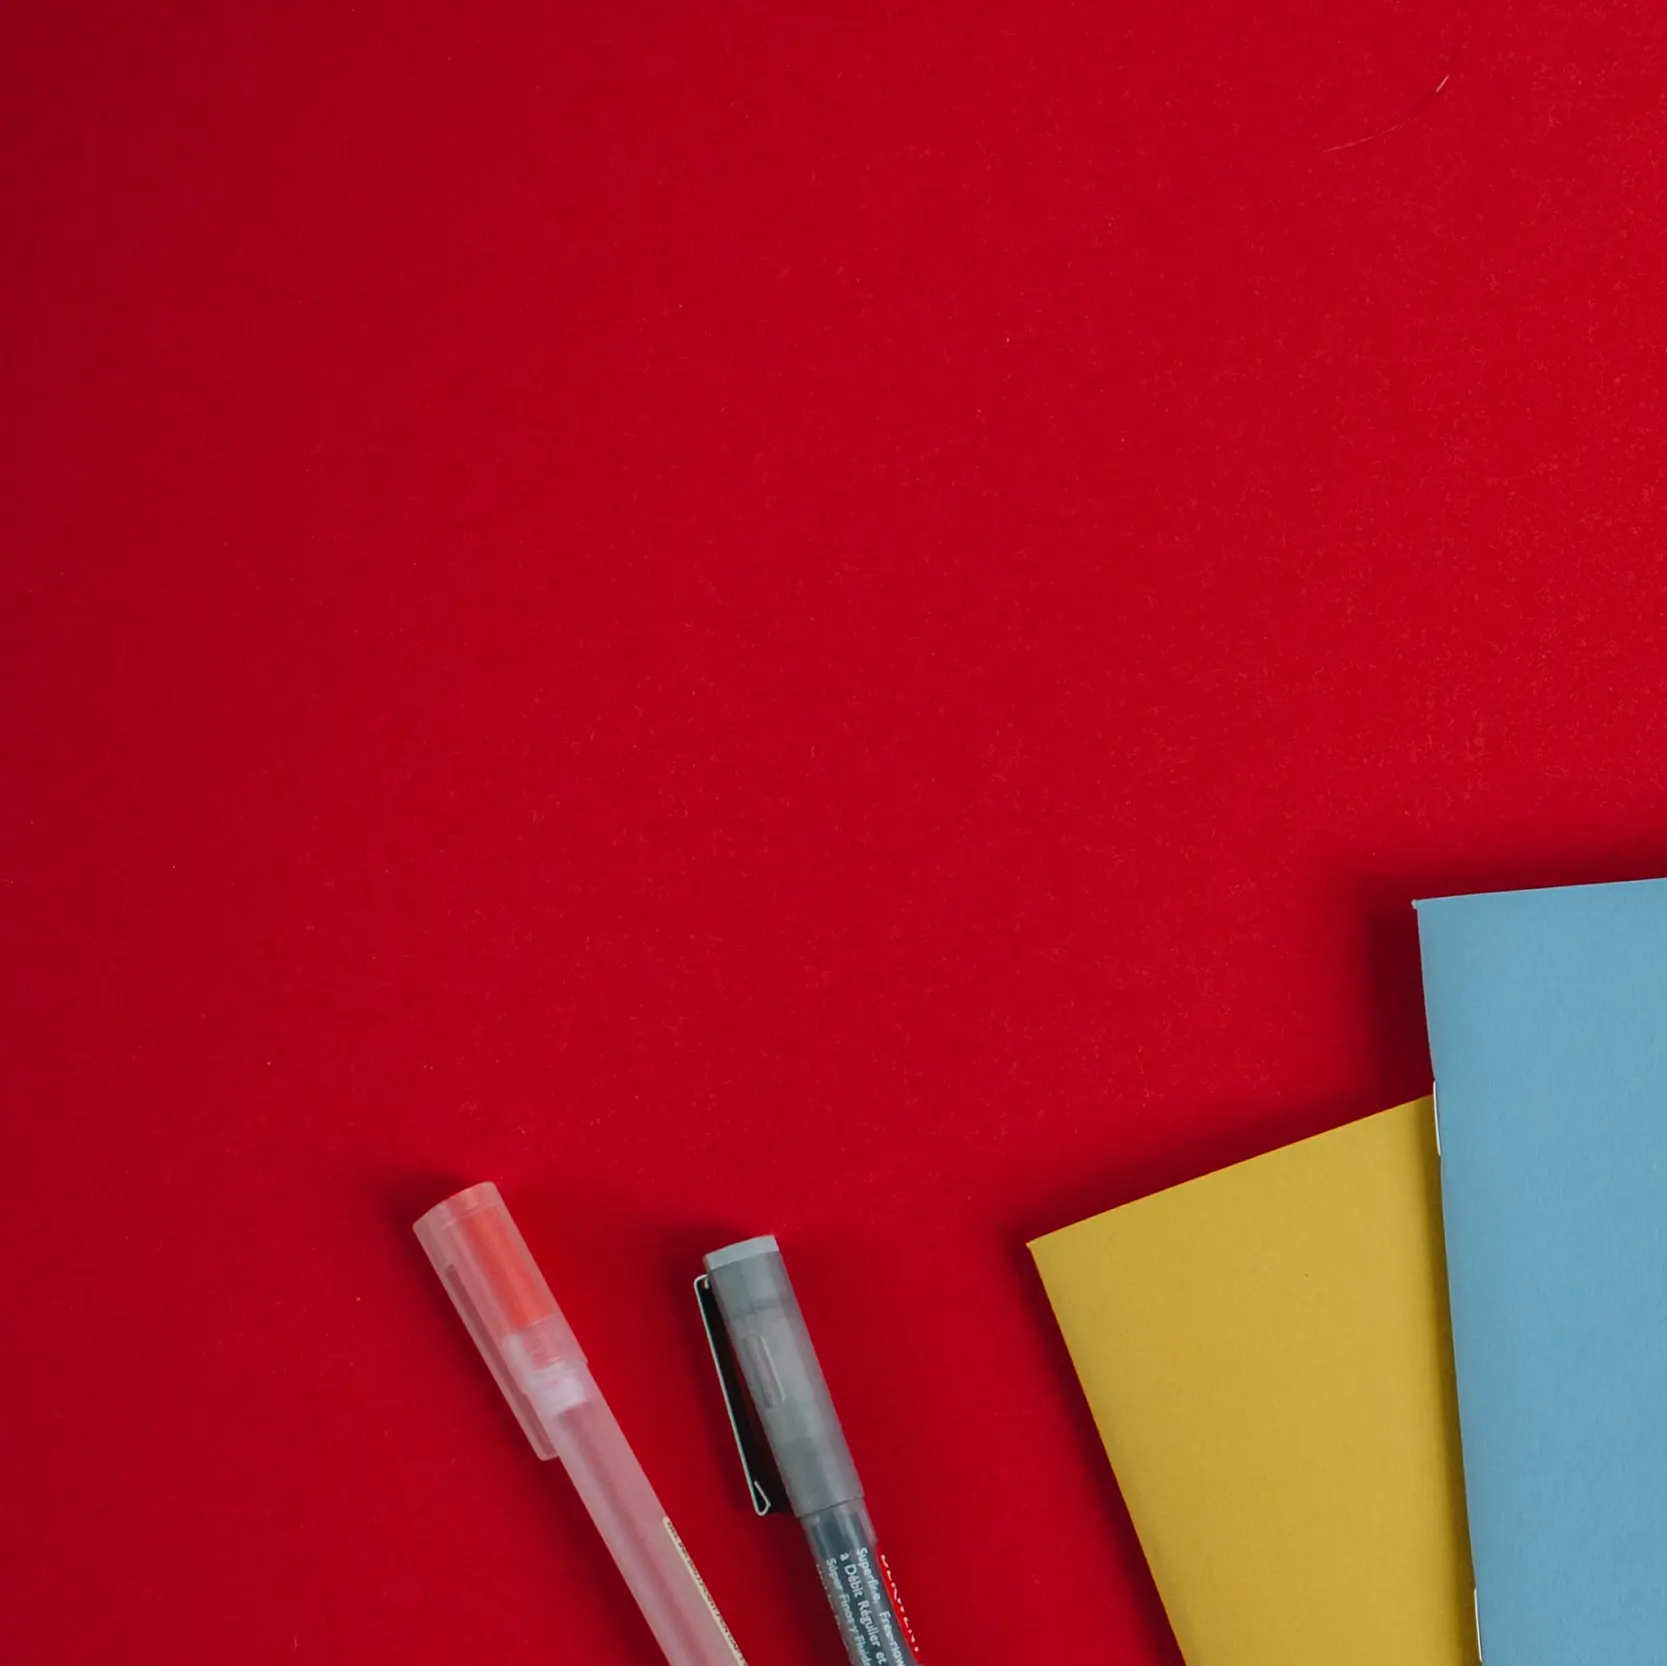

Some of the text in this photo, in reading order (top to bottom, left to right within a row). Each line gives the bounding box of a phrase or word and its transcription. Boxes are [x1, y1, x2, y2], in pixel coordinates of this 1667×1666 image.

[826, 1557, 844, 1591] Súper
[838, 1593, 855, 1624] Finos
[848, 1625, 859, 1634] y
[844, 1563, 864, 1598] Débit
[857, 1600, 881, 1647] Régulier
[875, 1651, 887, 1665] et
